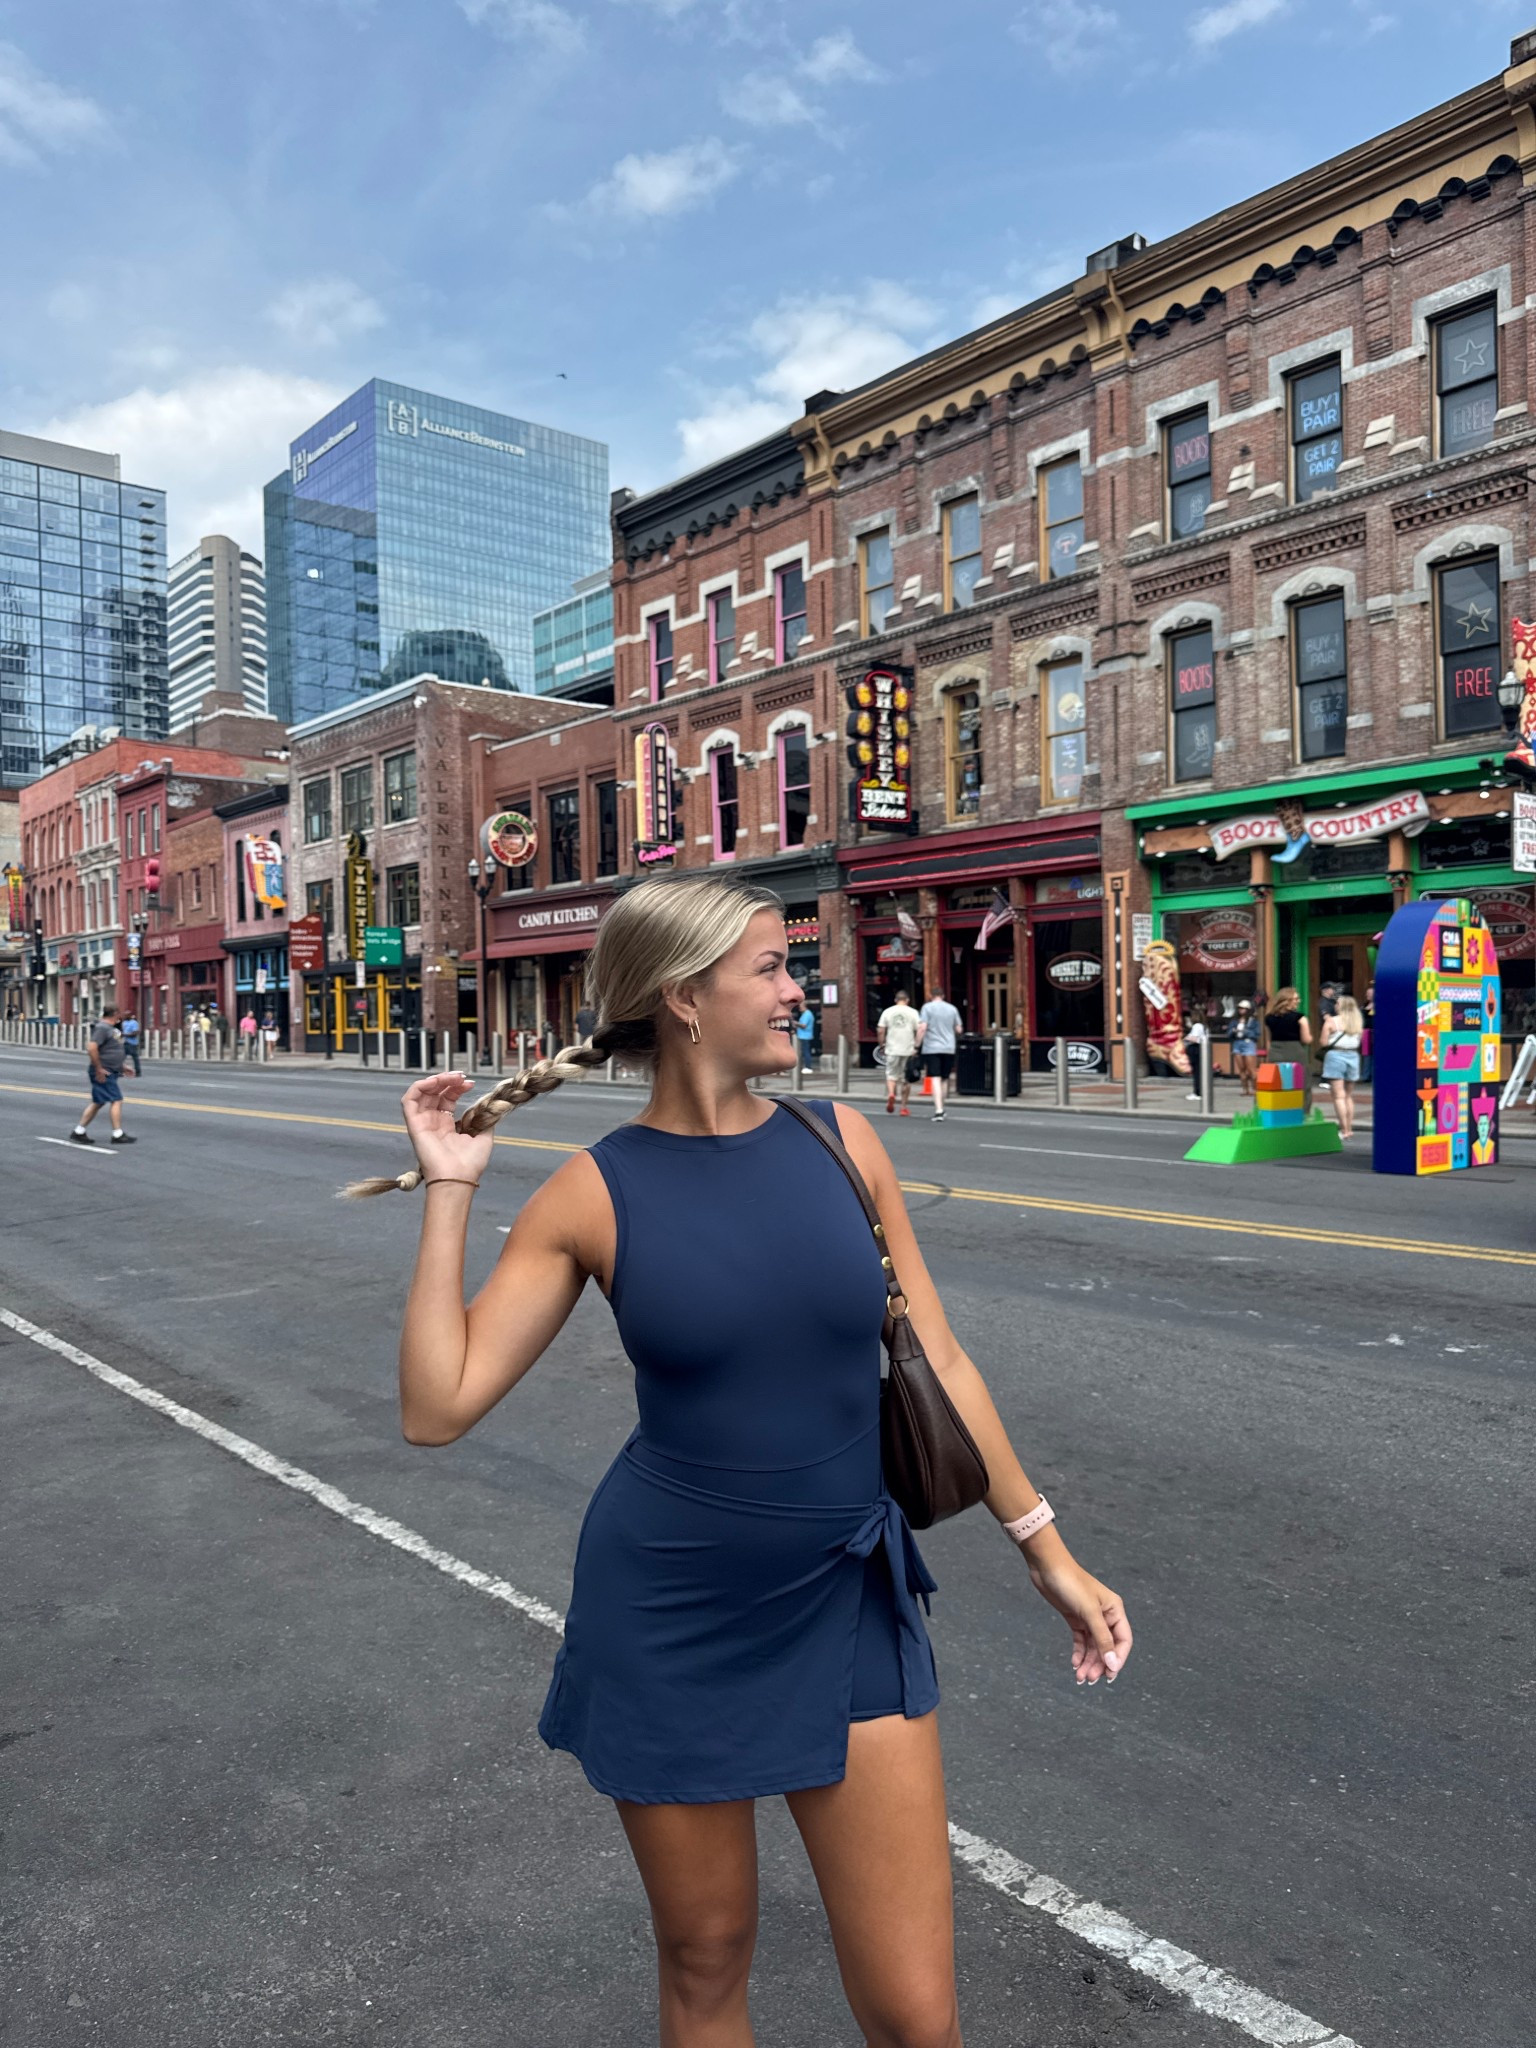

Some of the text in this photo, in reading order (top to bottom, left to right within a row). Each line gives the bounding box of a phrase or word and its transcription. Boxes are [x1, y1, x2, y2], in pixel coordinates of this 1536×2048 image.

[1301, 391, 1340, 417] BUY 1
[1303, 408, 1337, 432] PAIR
[1451, 399, 1491, 435] FREE
[1174, 434, 1209, 468] BOOTS
[1304, 438, 1340, 462] GET 2
[1309, 456, 1335, 477] PAIR
[1305, 633, 1331, 653] BUY
[1310, 647, 1337, 667] PAIR
[1179, 663, 1213, 694] BOOTS
[1455, 666, 1493, 699] FREE
[1308, 695, 1344, 714] GET 2
[873, 676, 895, 788] WHISKEY
[1314, 711, 1340, 729] PAIR
[861, 789, 907, 806] BENT
[434, 735, 452, 923] VALENTINE
[1218, 794, 1420, 847] BOOT COUNTRY
[1474, 890, 1527, 905] OOTS
[518, 905, 598, 929] CANDY KITCHEN
